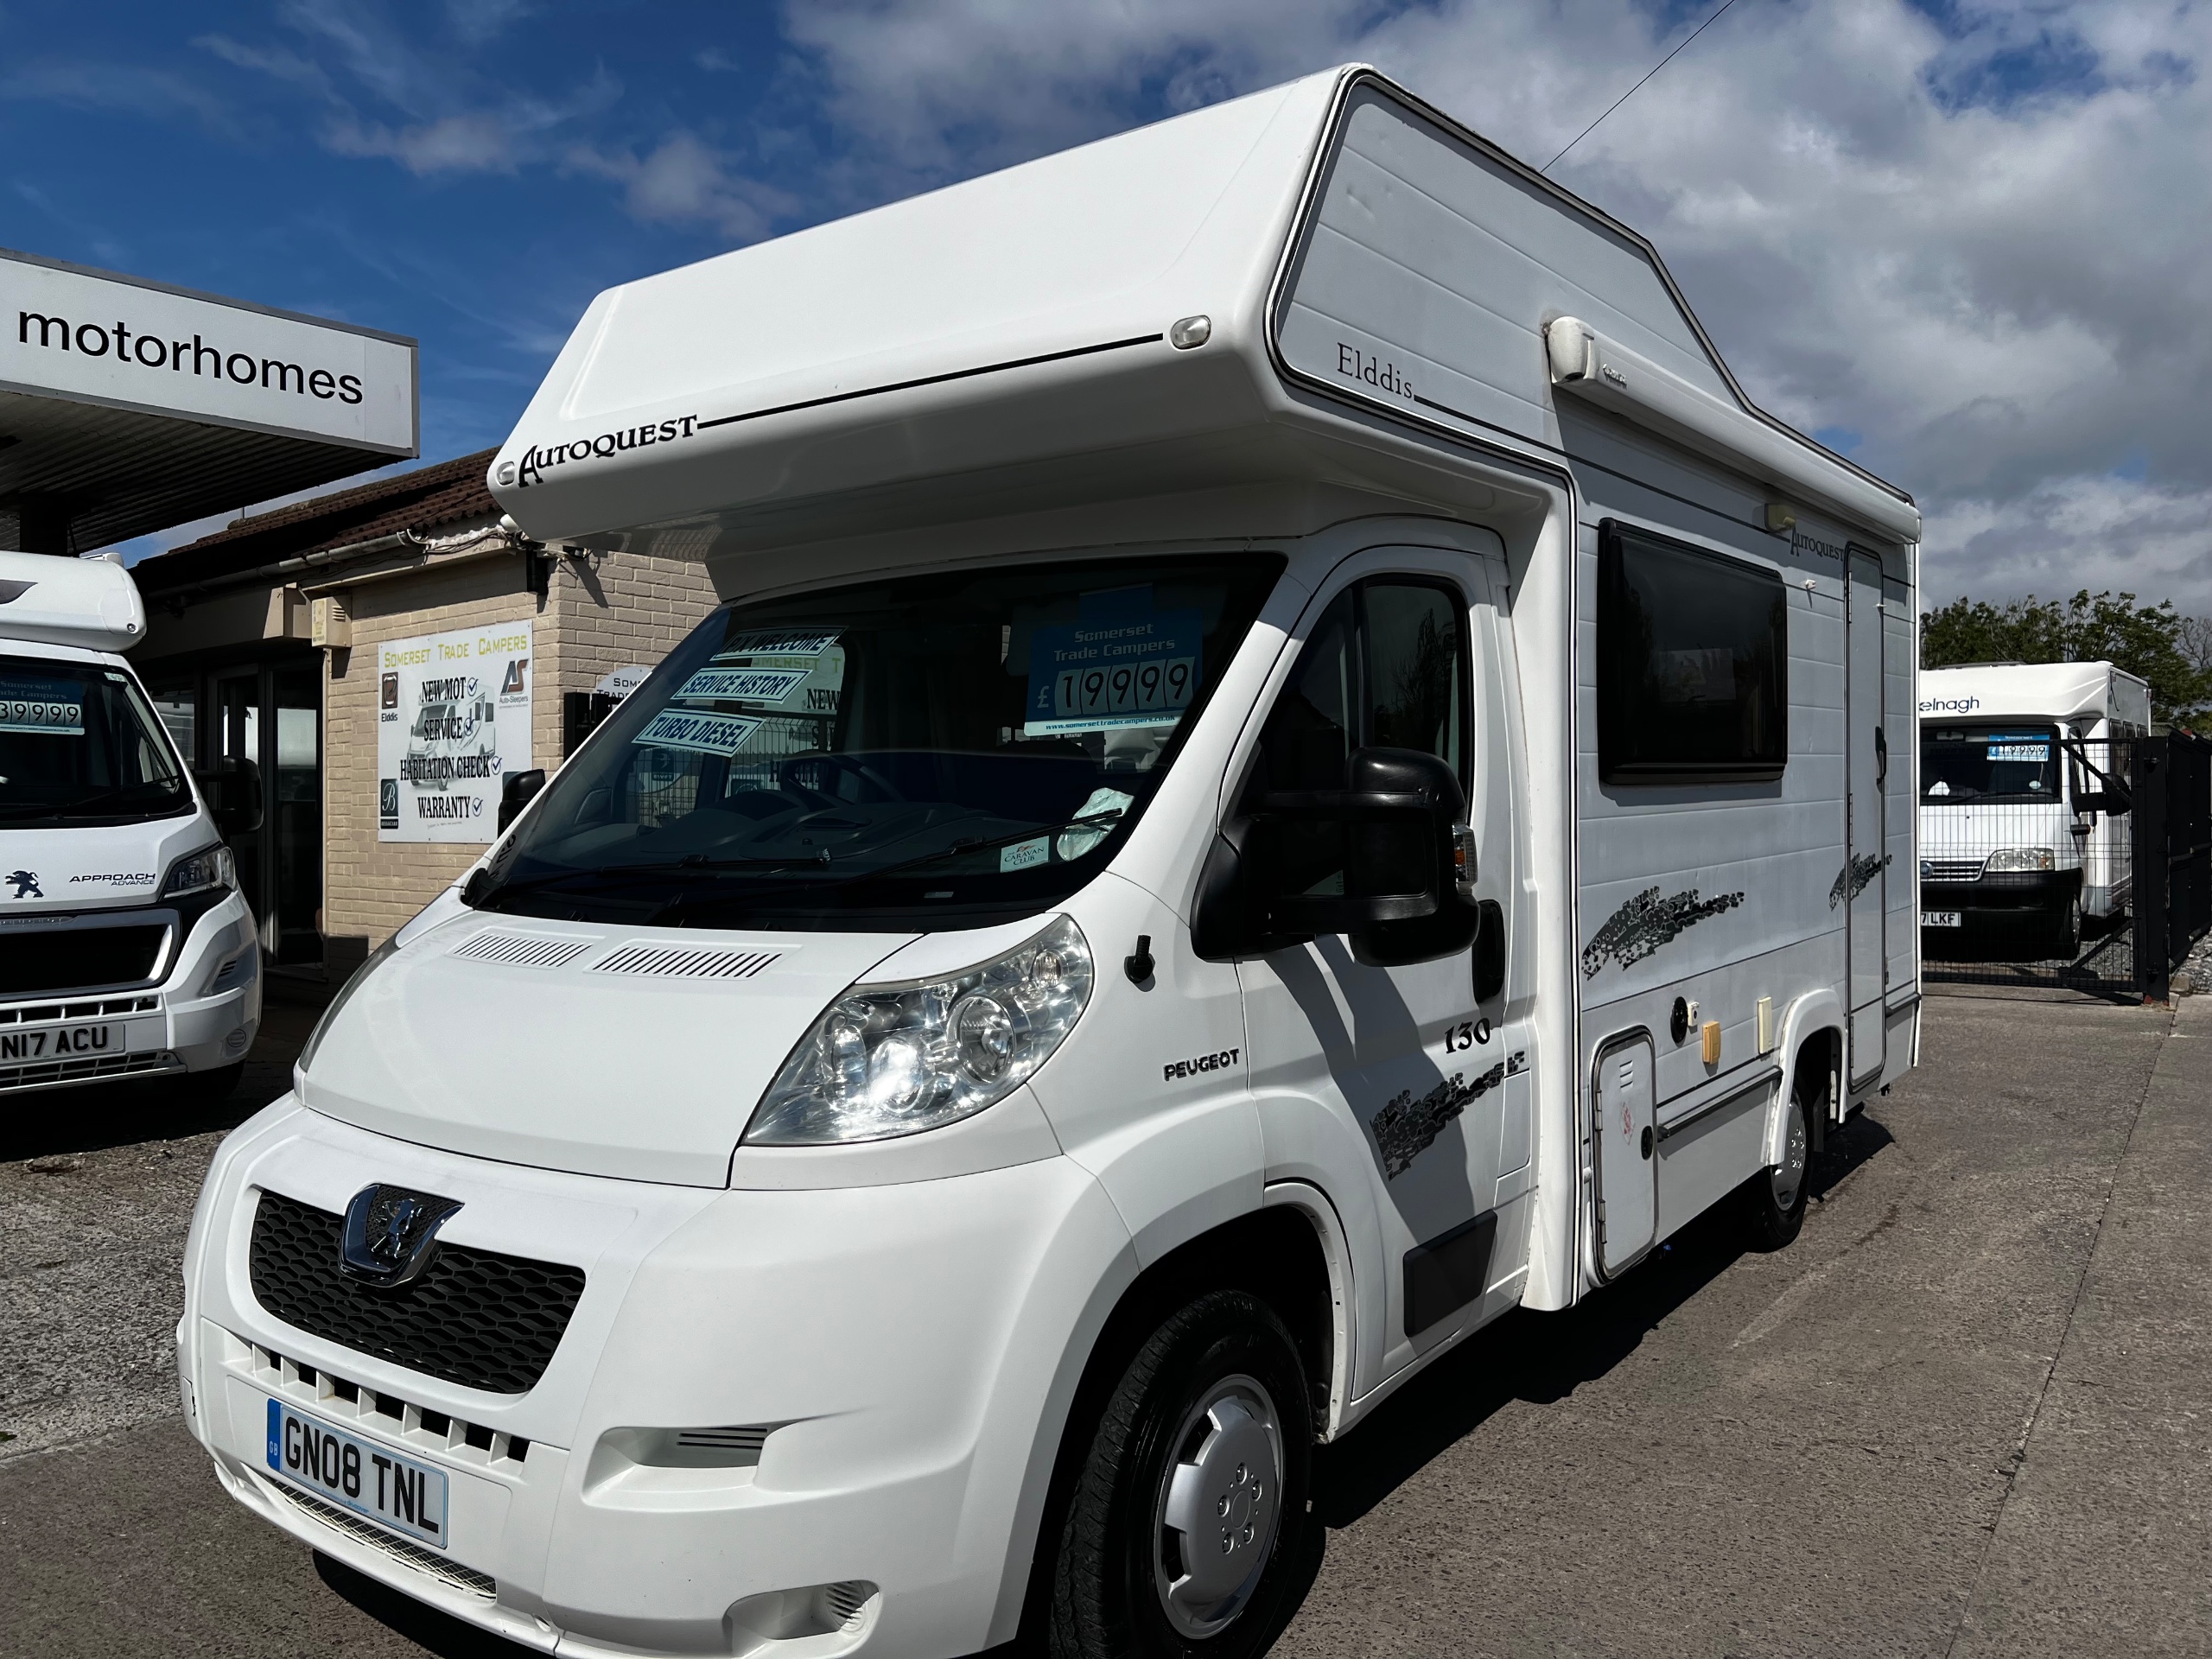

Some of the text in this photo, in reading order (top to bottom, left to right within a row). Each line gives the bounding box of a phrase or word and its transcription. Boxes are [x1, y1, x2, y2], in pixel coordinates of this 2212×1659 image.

[18, 311, 363, 404] motorhomes
[1337, 343, 1413, 398] Elddis
[518, 415, 697, 487] AUTOQUEST
[1789, 526, 1845, 562] AUTOQUEST
[751, 632, 835, 652] WELCOME
[1075, 623, 1154, 643] Somerset
[385, 635, 527, 668] SOMERSET TRADE CAMPERS
[1054, 639, 1175, 662] Trade Campers
[422, 677, 467, 702] NEW MOT
[682, 674, 798, 696] SERVICE HISTORY
[1038, 663, 1189, 709] £ 19999
[381, 713, 398, 722] Elddis
[423, 717, 462, 741] SERVICE
[1046, 715, 1175, 730] www.somersettradecampers.co.uk
[645, 716, 749, 747] TURBO DIESEL
[400, 755, 490, 781] HABITATION CHECK
[417, 796, 471, 819] WARRANTY
[1004, 847, 1045, 862] CARAVAN
[1013, 855, 1035, 865] CLUB
[69, 874, 156, 883] APPROACH
[1930, 912, 1955, 925] LKF
[2, 1027, 108, 1058] N17 ACU
[1444, 1018, 1491, 1054] 130
[1163, 1048, 1240, 1081] PEUGEOT
[269, 1440, 278, 1457] GB
[285, 1416, 439, 1535] GN08 TNL
